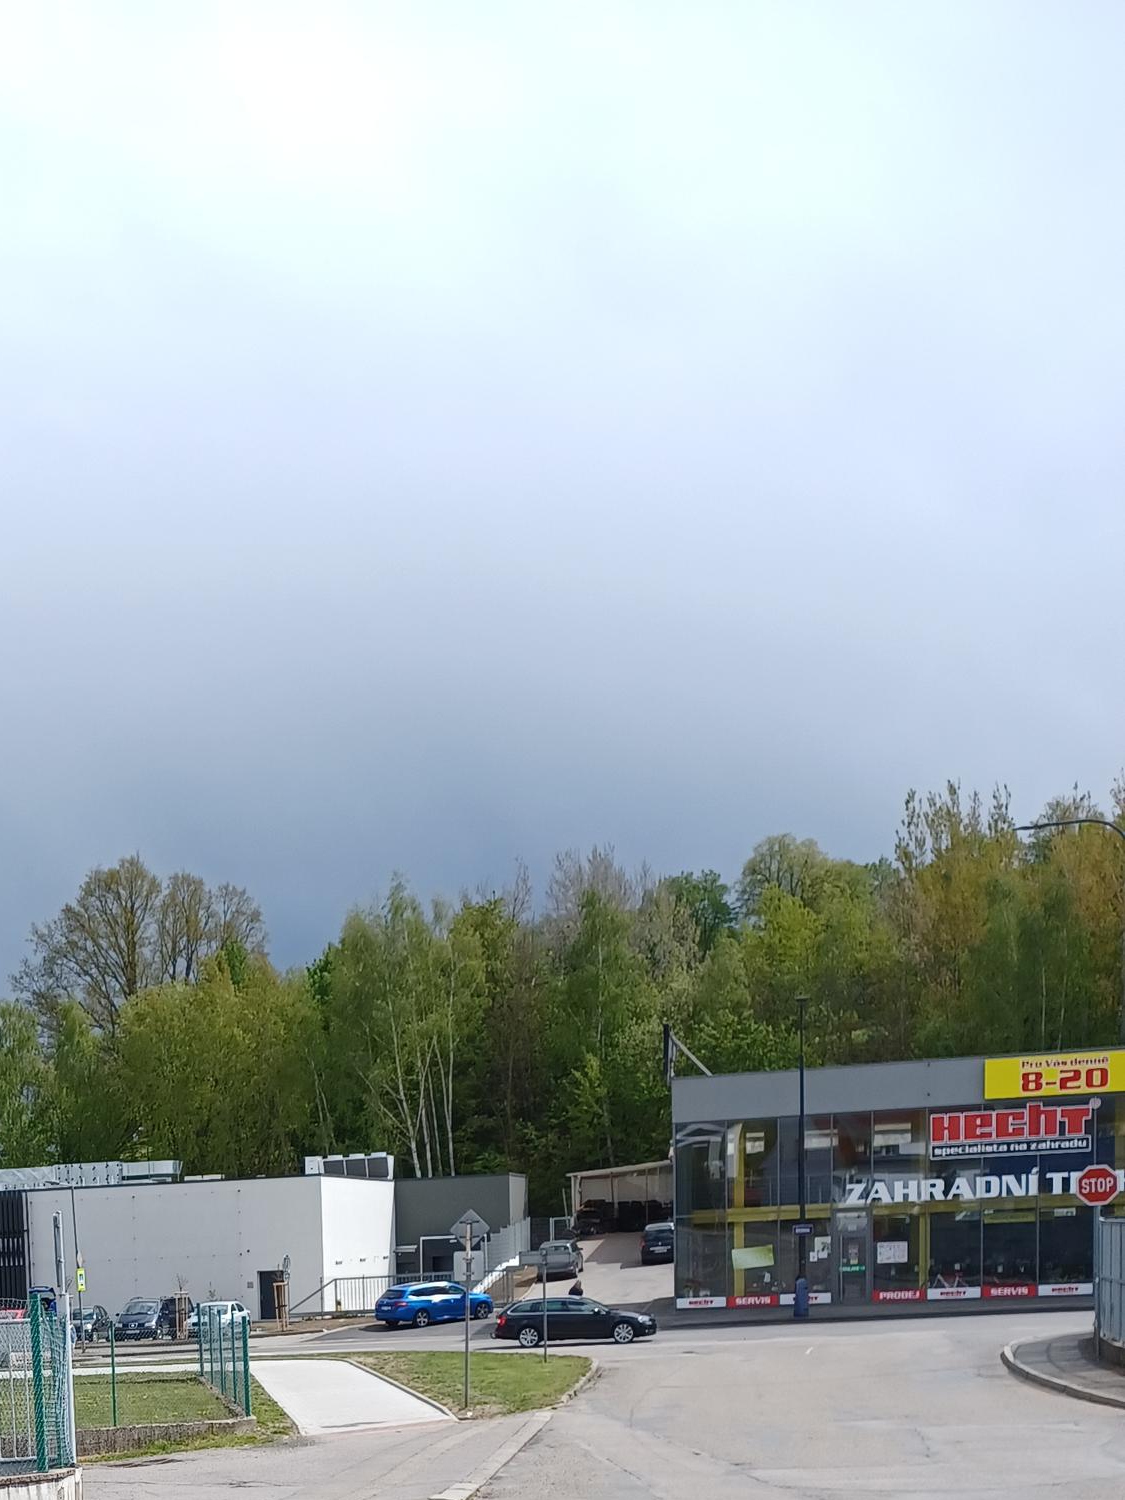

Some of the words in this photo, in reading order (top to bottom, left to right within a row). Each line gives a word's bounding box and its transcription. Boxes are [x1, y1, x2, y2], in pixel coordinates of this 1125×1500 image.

[1021, 1067, 1109, 1092] 8-20
[934, 1145, 1007, 1157] specialista
[1010, 1144, 1027, 1152] na
[1030, 1139, 1087, 1150] zahradu
[845, 1166, 1040, 1204] ZAHRADNÍ
[1081, 1176, 1114, 1194] STOP
[879, 1290, 920, 1300] PRODEJ
[990, 1286, 1028, 1296] SERVIS
[735, 1295, 771, 1306] SERVIS
